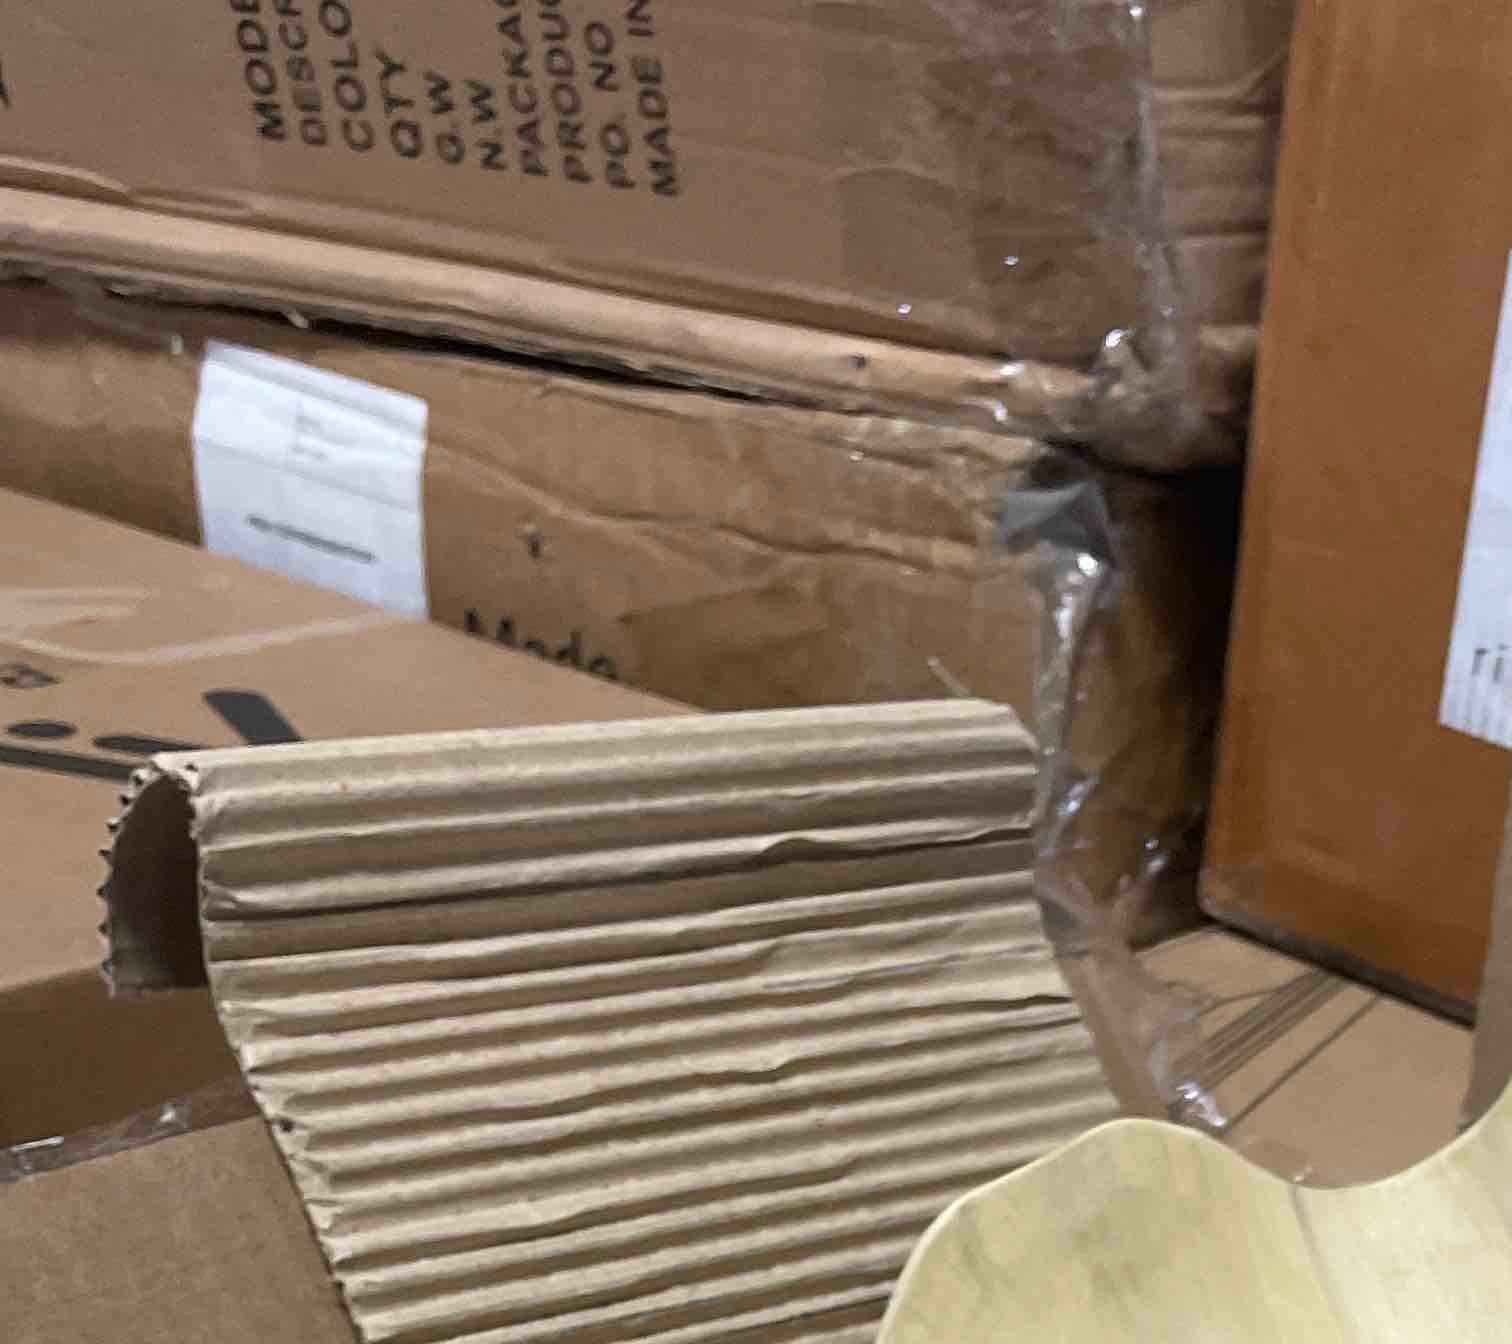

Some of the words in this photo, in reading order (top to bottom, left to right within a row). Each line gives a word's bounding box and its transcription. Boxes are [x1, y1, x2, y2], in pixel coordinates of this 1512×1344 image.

[318, 0, 375, 152] COLO
[374, 46, 423, 158] QTY
[537, 0, 593, 183] PRODU
[584, 20, 620, 92] NO
[630, 54, 681, 196] MADE
